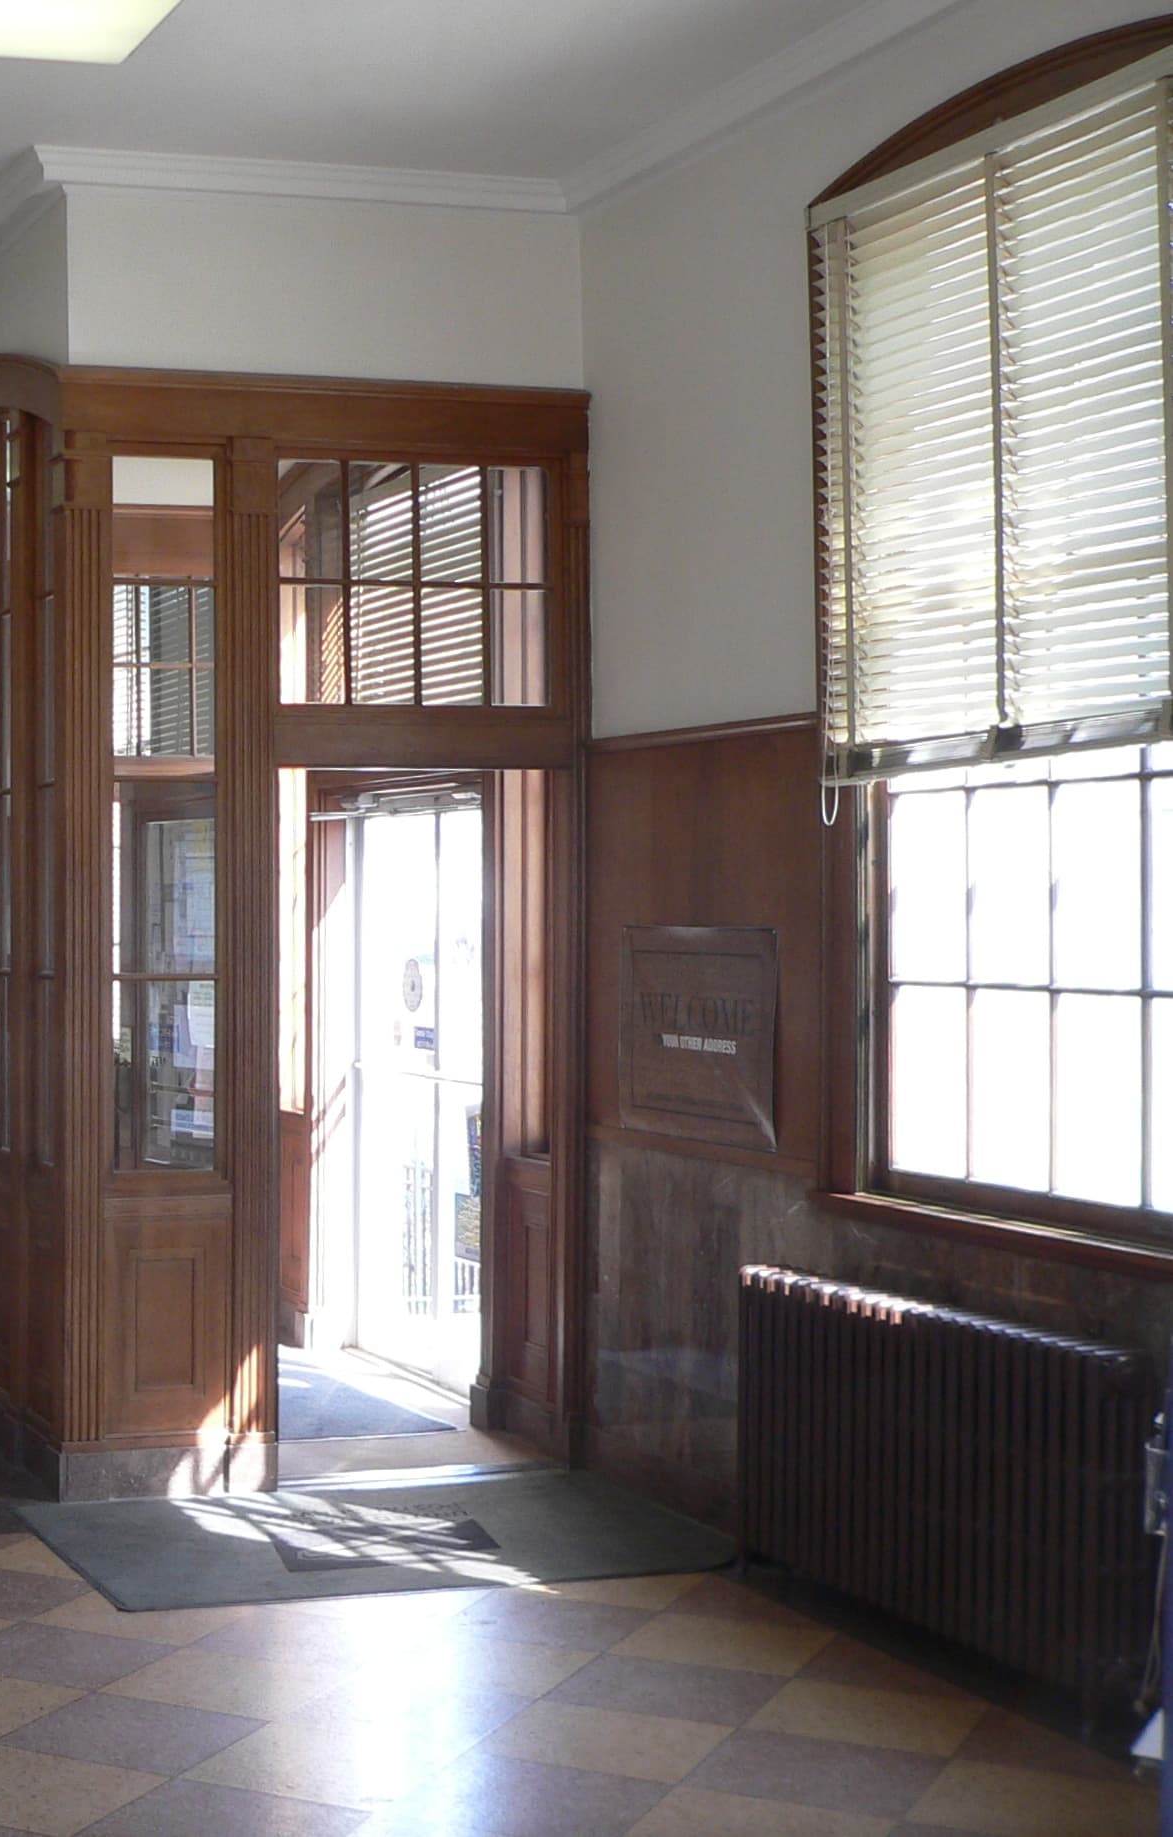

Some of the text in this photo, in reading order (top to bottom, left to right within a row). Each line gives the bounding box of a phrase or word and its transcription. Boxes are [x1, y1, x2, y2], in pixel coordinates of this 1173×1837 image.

[640, 991, 760, 1036] WELCOME
[681, 1035, 702, 1051] OTHER
[703, 1038, 737, 1055] ADDRESS
